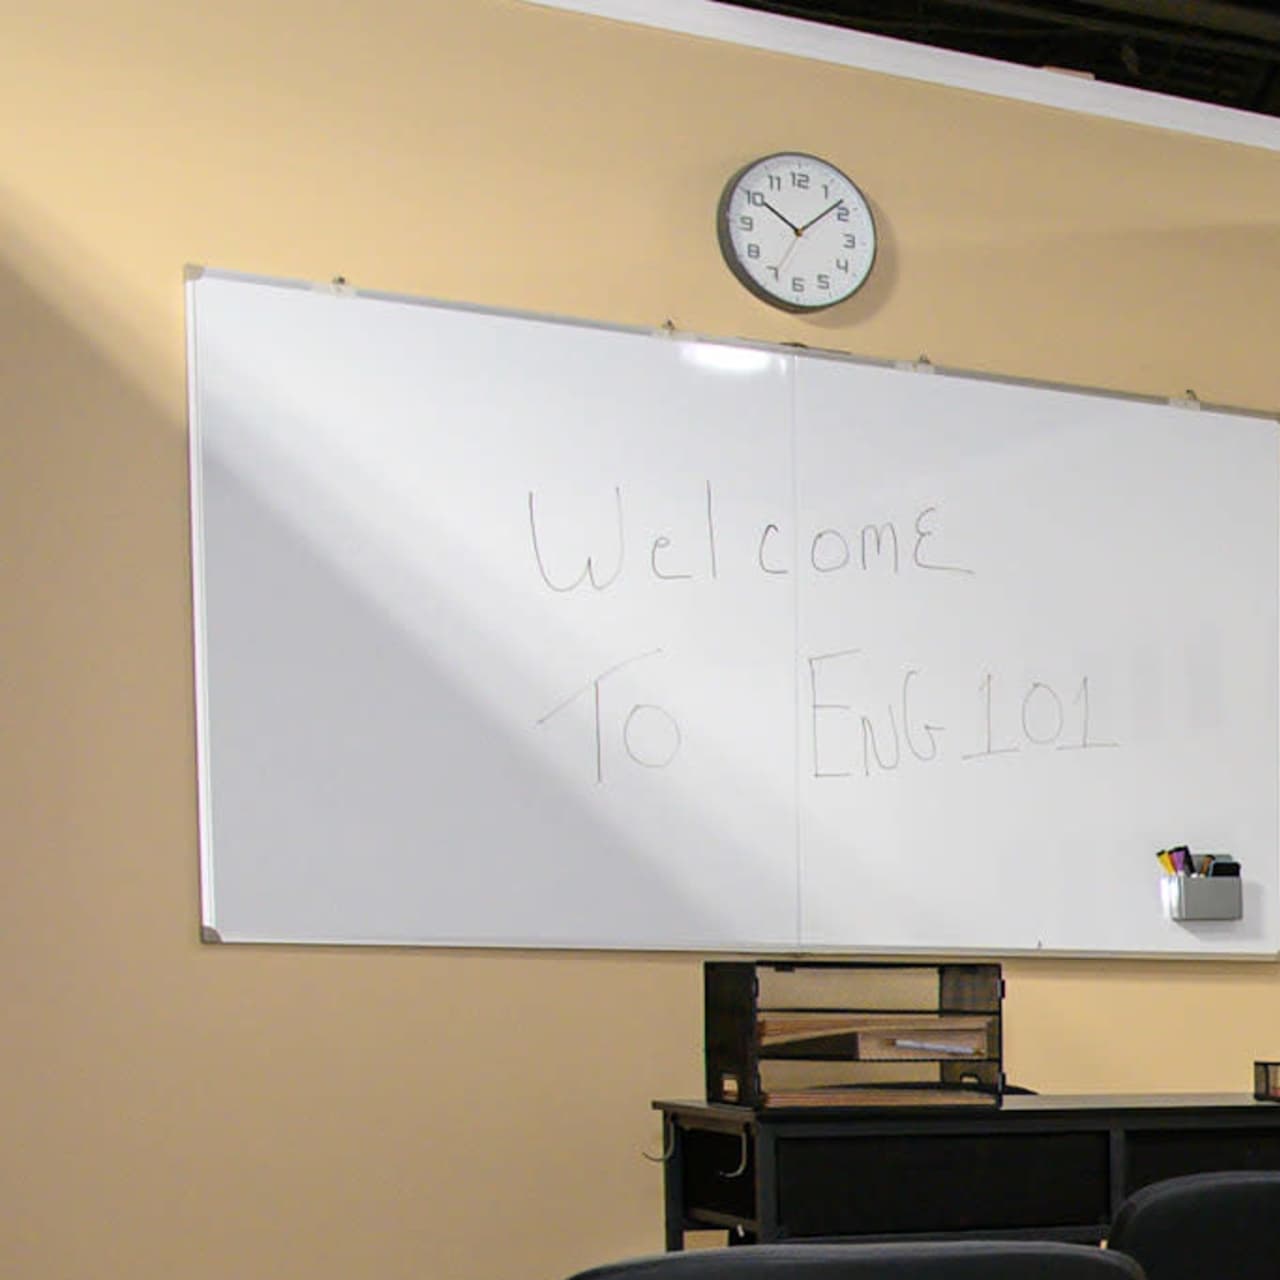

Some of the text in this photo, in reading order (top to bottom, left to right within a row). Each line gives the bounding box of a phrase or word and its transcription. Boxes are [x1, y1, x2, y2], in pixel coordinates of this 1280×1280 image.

[768, 174, 782, 191] 11
[790, 171, 810, 190] 12
[746, 190, 765, 207] 10
[822, 185, 829, 199] 1
[837, 206, 850, 222] 2
[740, 216, 754, 231] 9
[844, 233, 856, 249] 3
[748, 244, 760, 258] 8
[767, 265, 779, 280] 7
[836, 259, 848, 272] 4
[792, 277, 804, 292] 6
[817, 274, 830, 290] 5
